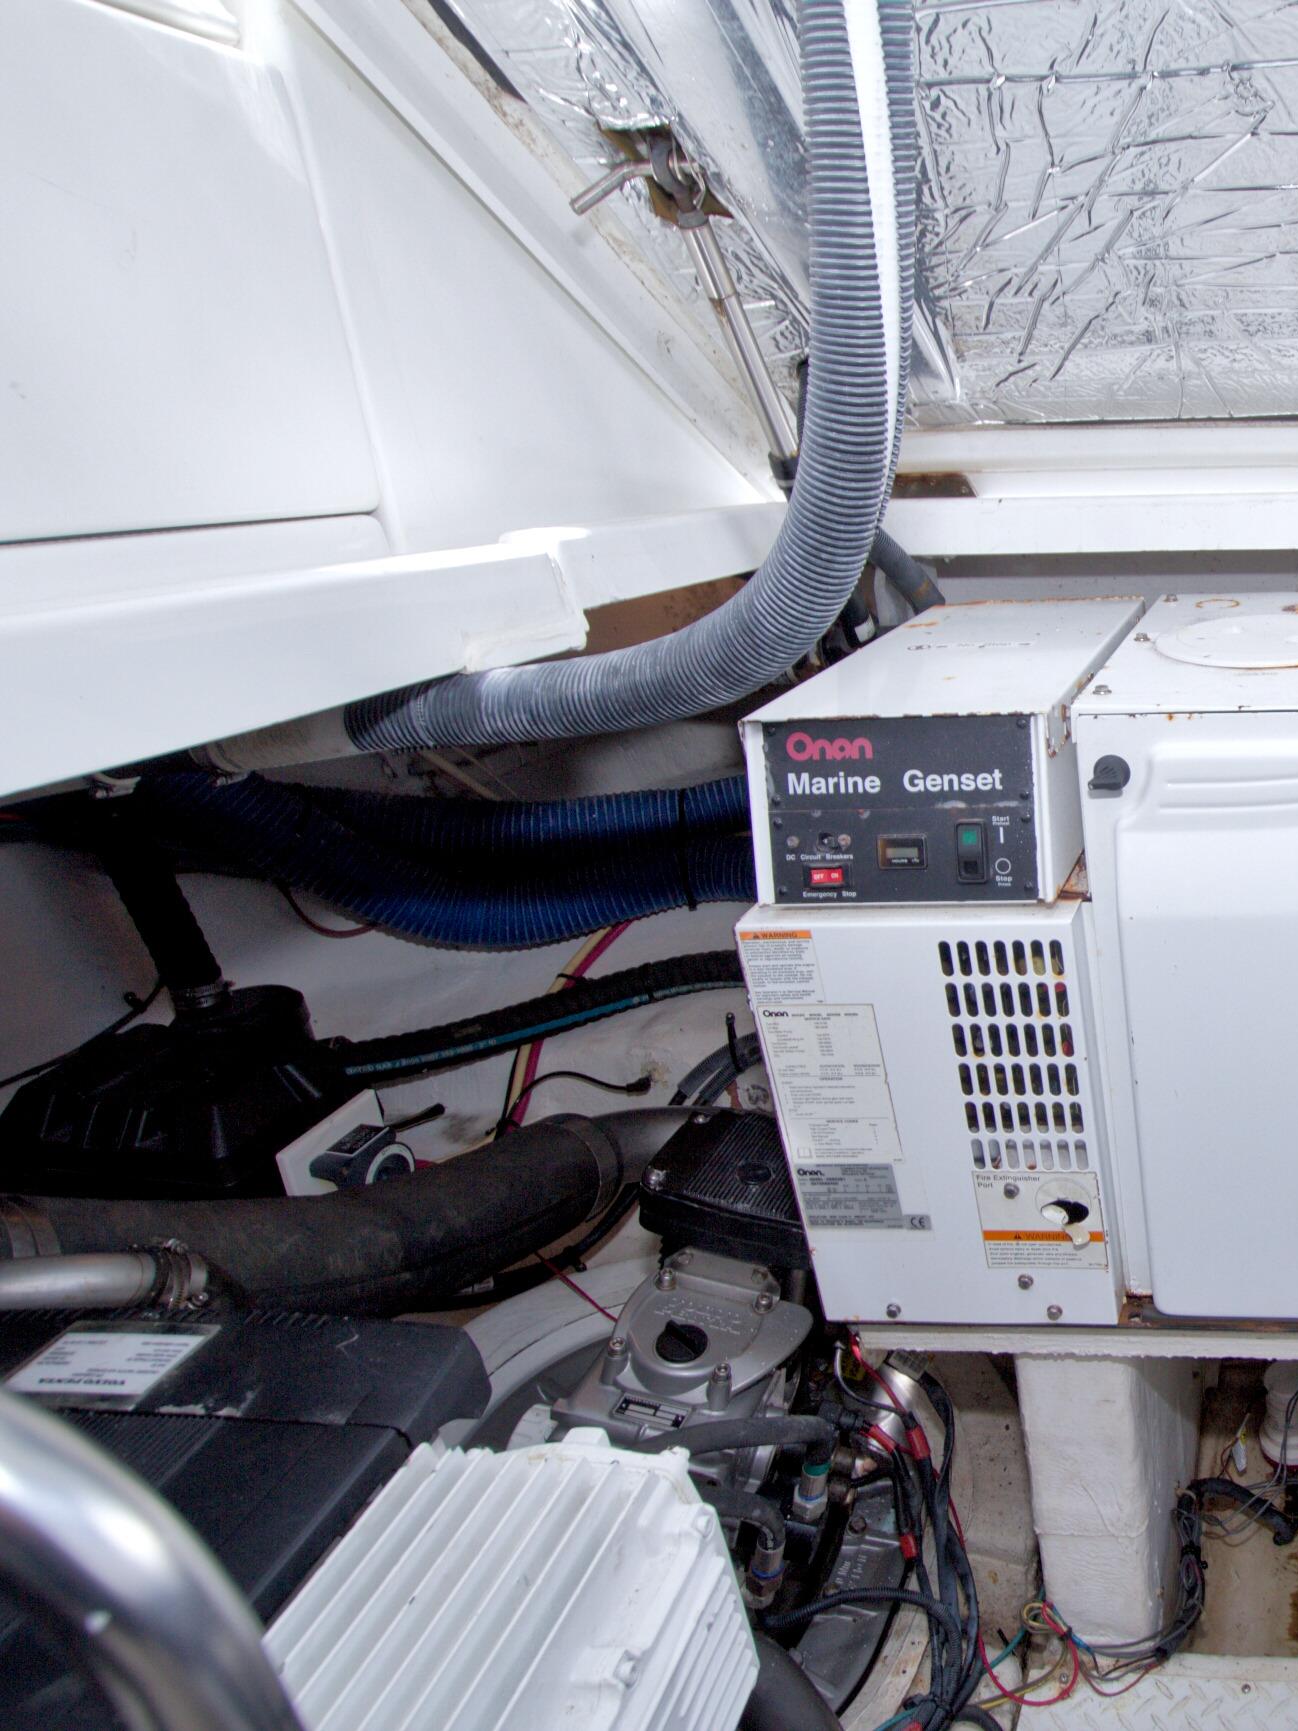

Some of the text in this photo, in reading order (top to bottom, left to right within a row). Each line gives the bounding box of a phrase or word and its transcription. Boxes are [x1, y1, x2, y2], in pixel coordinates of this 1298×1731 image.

[786, 732, 873, 761] Onan
[788, 769, 1003, 795] Marine Genset
[797, 1168, 822, 1176] Onan
